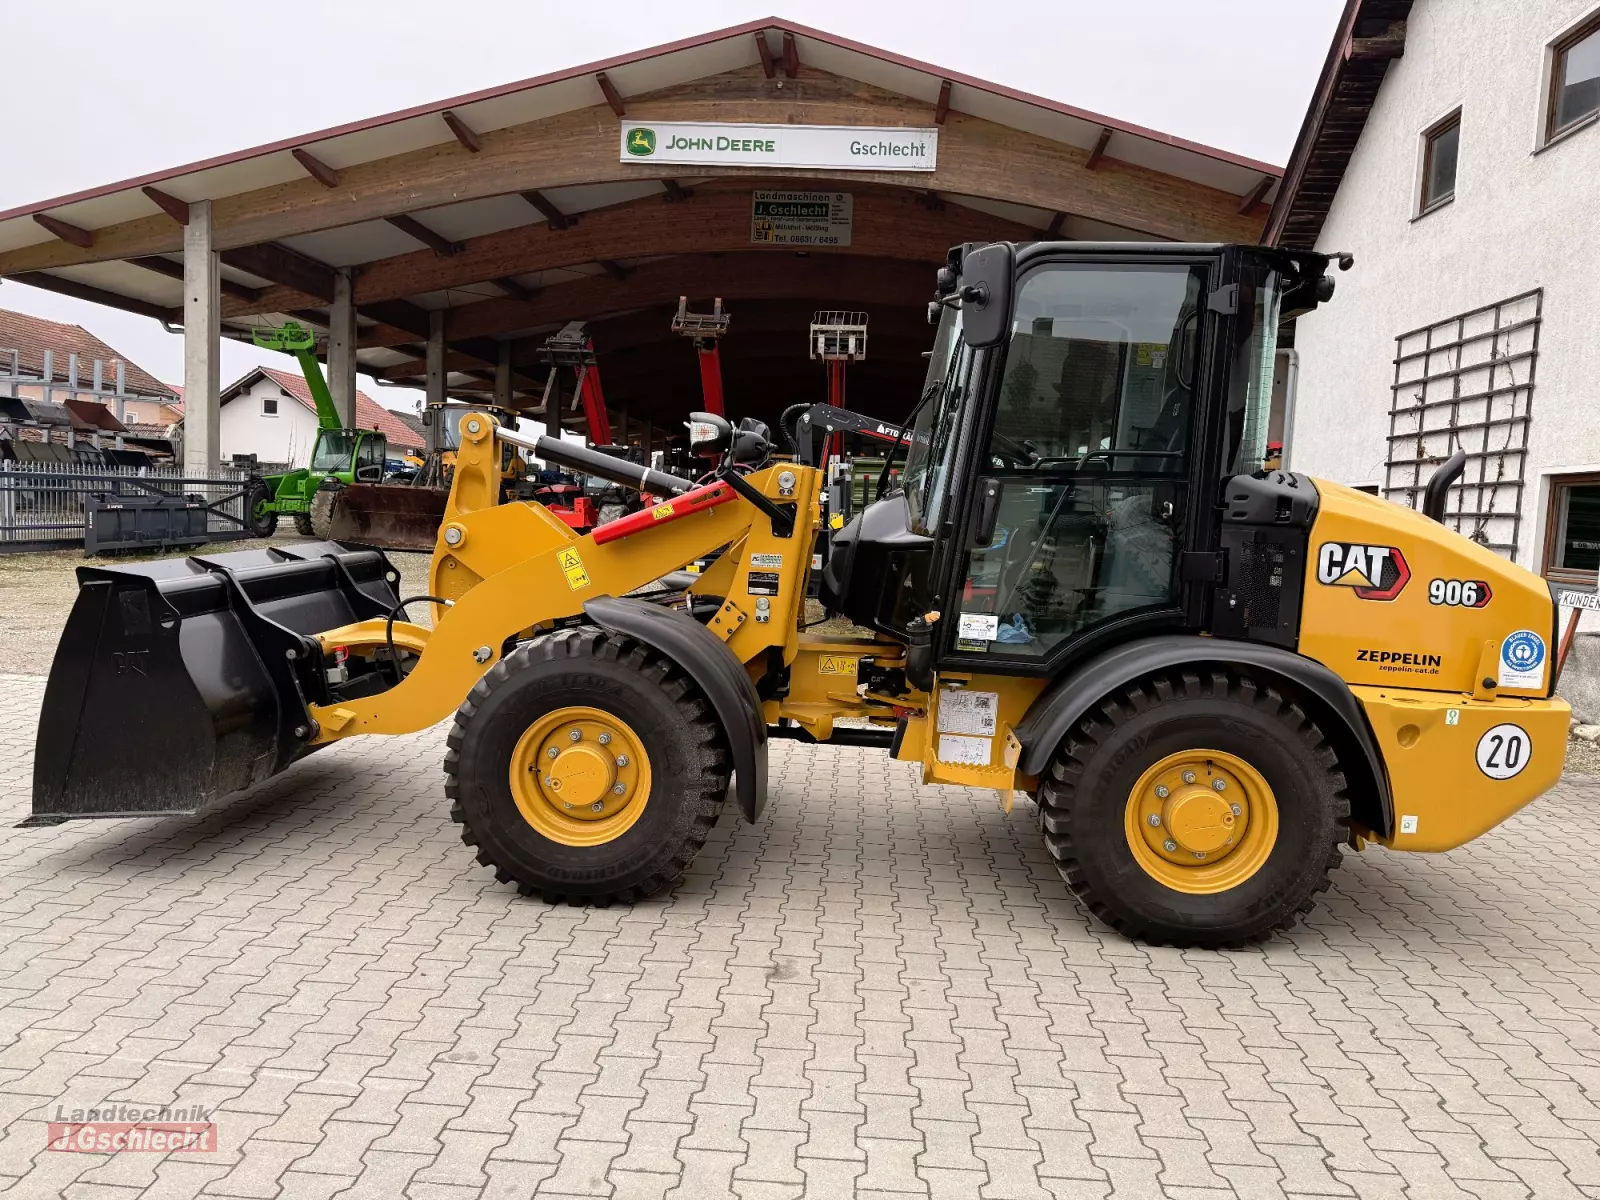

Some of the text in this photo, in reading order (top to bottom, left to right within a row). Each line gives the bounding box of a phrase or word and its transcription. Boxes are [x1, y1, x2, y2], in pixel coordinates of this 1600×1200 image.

[665, 135, 776, 152] JOHN DEERE
[850, 140, 926, 157] Gschlecht
[754, 192, 830, 202] Landmaschinen
[757, 203, 826, 216] J. Gschlecht
[774, 234, 788, 242] Tel.
[1318, 542, 1390, 588] CAT
[1429, 579, 1478, 606] 906
[1356, 649, 1441, 667] ZEPPELIN
[1379, 665, 1440, 675] zeppelin-cat.de
[1486, 734, 1522, 769] 20
